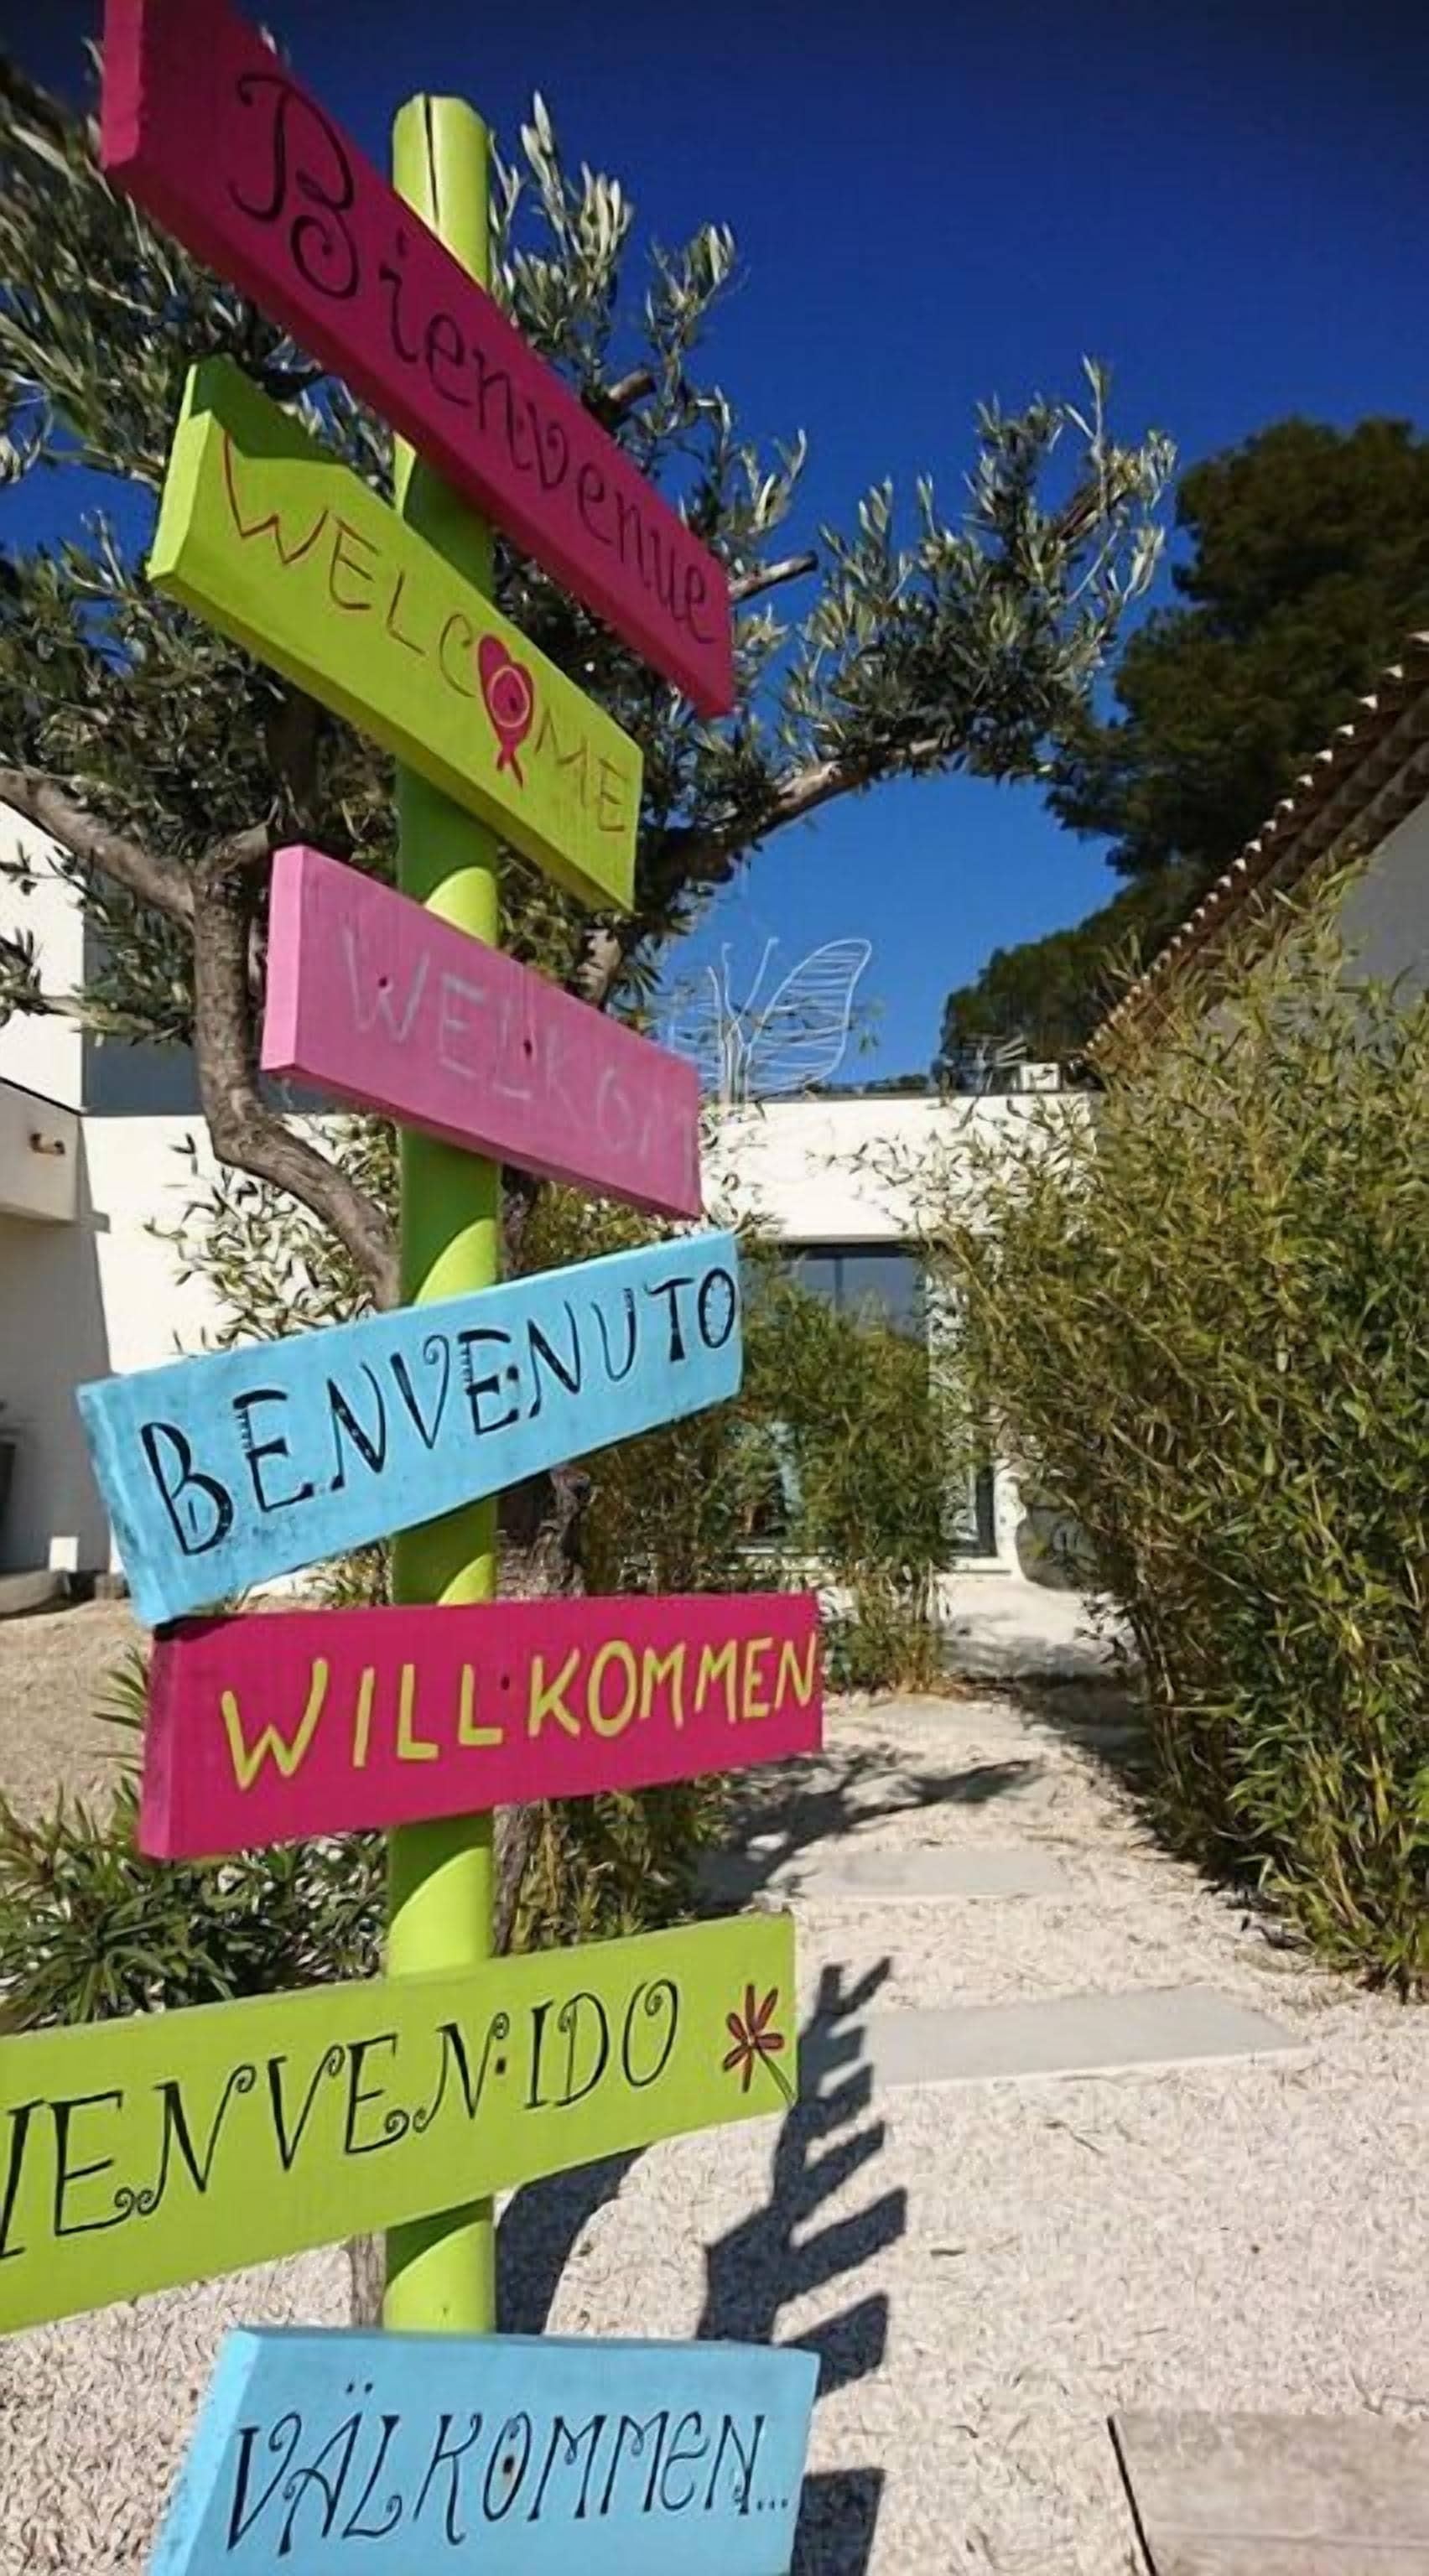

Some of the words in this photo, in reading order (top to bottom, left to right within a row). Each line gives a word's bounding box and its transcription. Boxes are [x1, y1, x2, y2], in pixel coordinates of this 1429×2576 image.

[228, 74, 718, 644] Bienvenue
[223, 431, 626, 832] WELCOME
[342, 926, 696, 1187] WELKOM
[141, 1268, 736, 1556] BENVENUTO
[220, 1631, 818, 1790] WILLKOMMEN
